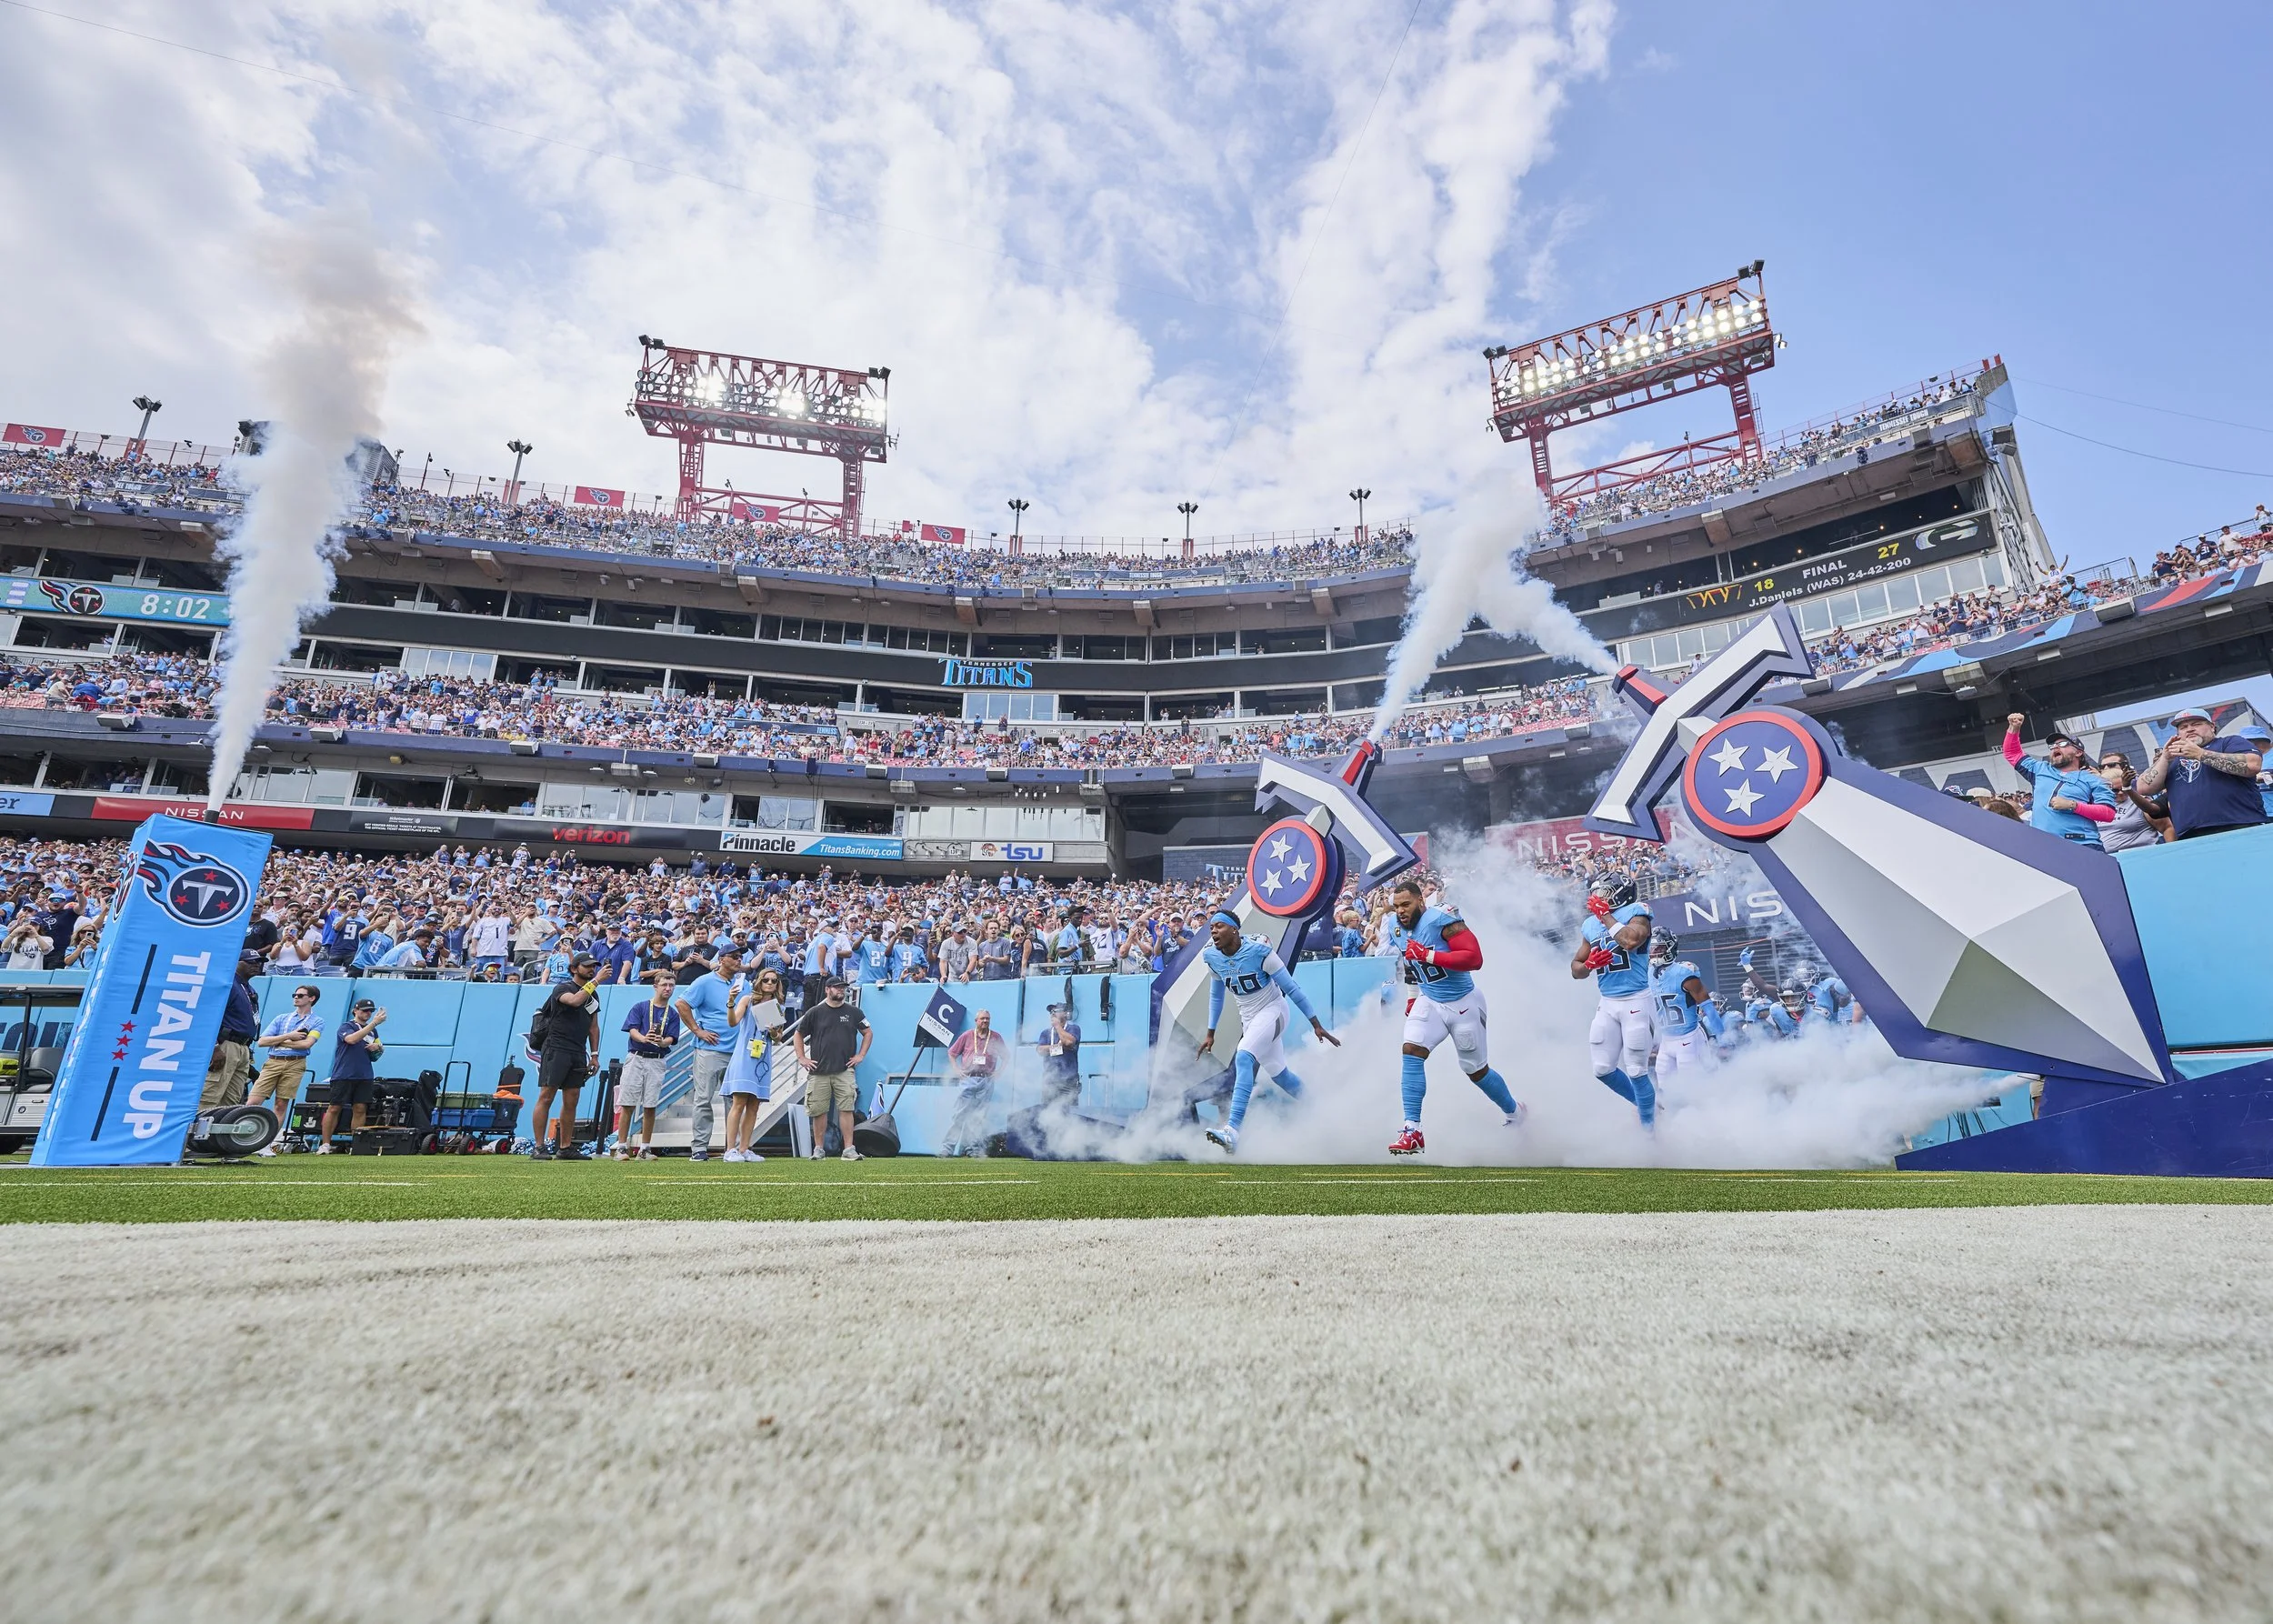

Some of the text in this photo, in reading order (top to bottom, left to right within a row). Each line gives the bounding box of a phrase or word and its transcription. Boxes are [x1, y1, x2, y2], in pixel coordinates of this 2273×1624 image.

[1877, 543, 1899, 560] 27
[1803, 559, 1847, 579] FINAL
[1748, 556, 1911, 607] J.Daniels (WAS) 24-42-200
[1754, 578, 1774, 593] 18
[141, 594, 210, 619] 8:02
[938, 657, 1032, 687] TITANS
[165, 807, 244, 820] NISAN
[552, 827, 630, 845] verizon
[722, 833, 796, 852] Pinnacle
[820, 844, 900, 857] TitansBanking.com
[1001, 844, 1043, 860] tsu
[343, 924, 357, 940] 9
[368, 937, 381, 954] 8
[556, 964, 564, 972] 6
[1225, 973, 1263, 996] 40
[938, 1004, 954, 1024] C
[926, 1017, 950, 1037] NISSAN
[123, 951, 211, 1139] TITAN UP
